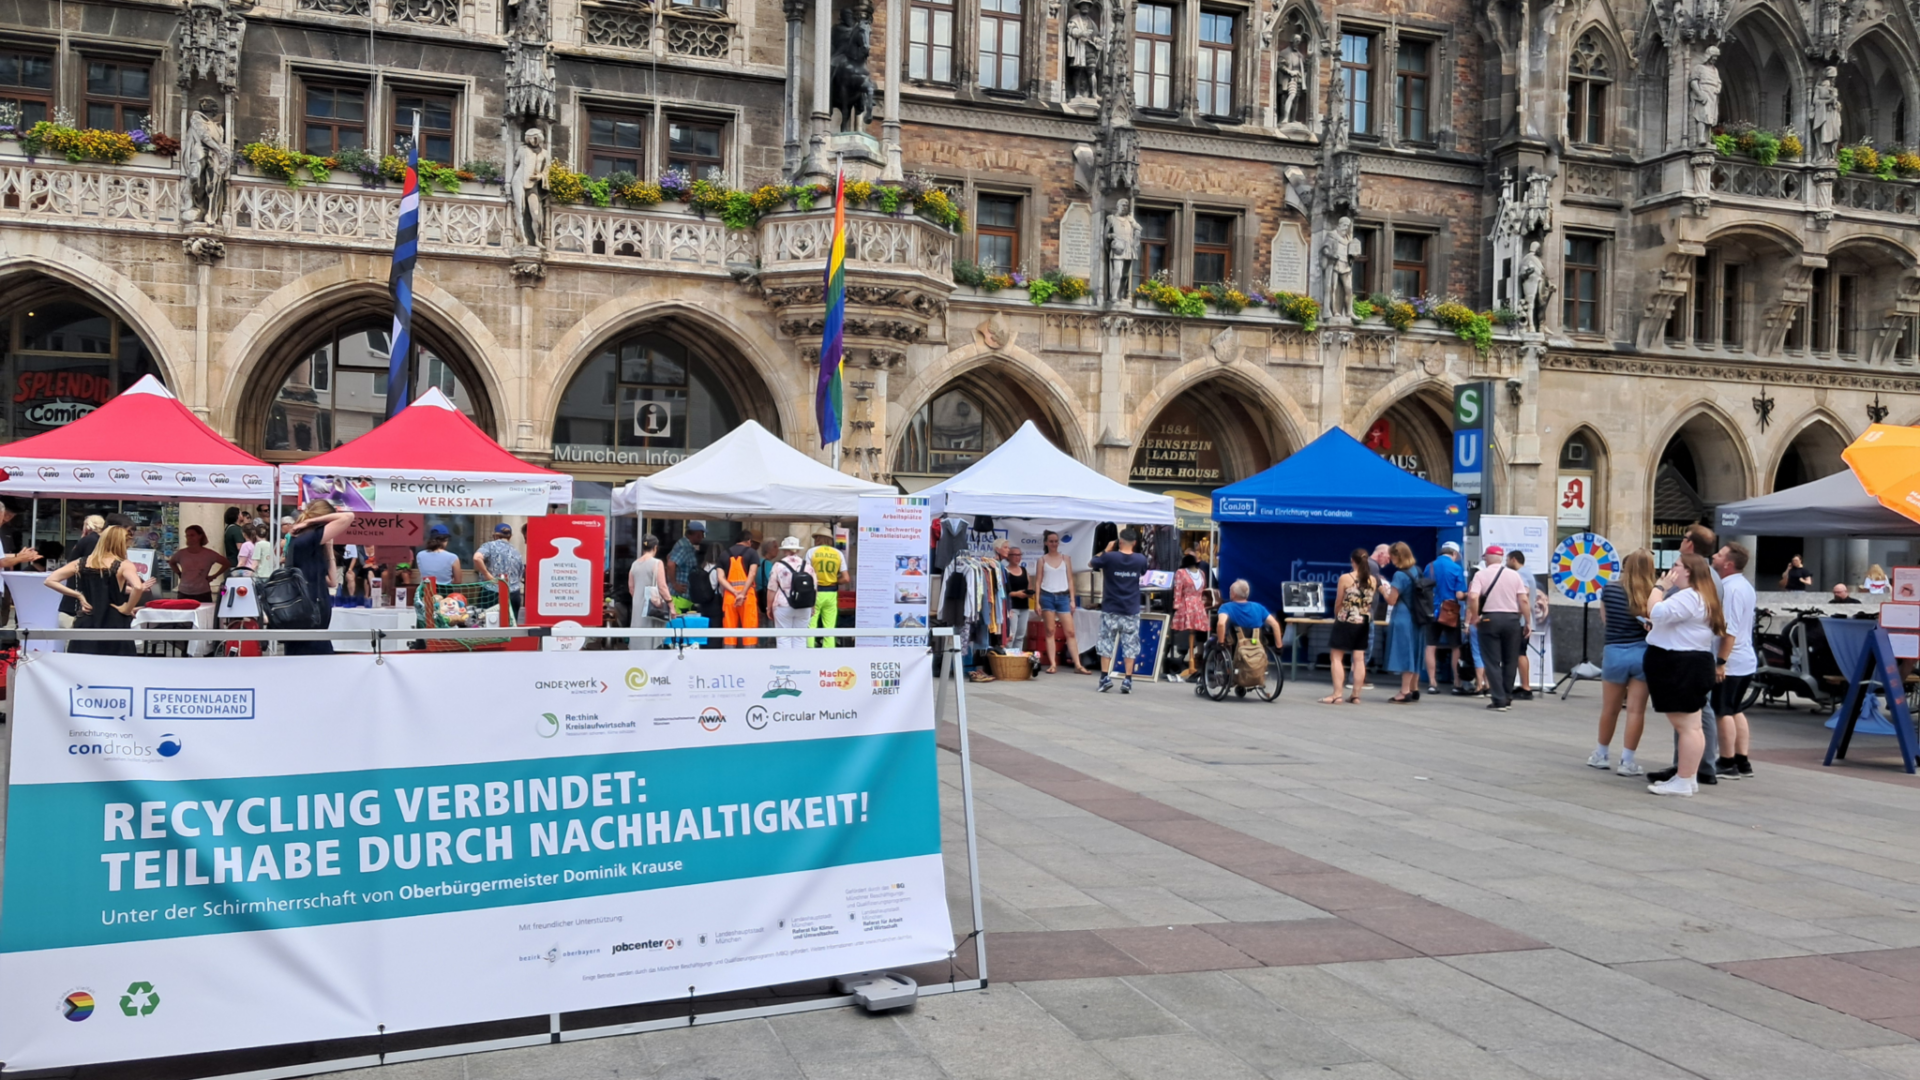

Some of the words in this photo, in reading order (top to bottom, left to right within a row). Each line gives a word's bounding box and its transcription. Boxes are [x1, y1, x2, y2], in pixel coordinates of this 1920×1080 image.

[1459, 390, 1478, 423] S
[1160, 425, 1190, 435] 1884
[1138, 439, 1213, 450] BERNSTEIN
[554, 445, 639, 464] München
[646, 450, 695, 466] Infor
[1152, 450, 1197, 460] LADEN
[1459, 434, 1476, 467] U
[1380, 453, 1417, 469] AUS
[1130, 467, 1172, 476] AMBER
[1178, 468, 1219, 478] HOUSE
[390, 482, 471, 495] RECYCLING-
[1453, 481, 1481, 489] Marienplatz
[417, 496, 493, 508] WERKSTATT
[1223, 502, 1251, 511] ConJob
[1260, 507, 1273, 515] Eine
[1275, 508, 1309, 517] Einrichtung
[882, 513, 922, 521] Arbeitsplätze
[885, 526, 922, 534] hochwertige
[818, 560, 836, 573] 10
[1297, 569, 1344, 583] ConJo
[893, 636, 928, 644] REGEN
[870, 662, 900, 670] REGEN
[819, 670, 848, 678] Machs
[870, 670, 900, 679] BOGEN
[696, 674, 745, 689] h.alle
[819, 680, 842, 688] Ganz
[872, 687, 900, 695] ARBEIT
[76, 698, 126, 709] CONJOB
[153, 693, 247, 704] SPENDENLADEN
[153, 704, 161, 714] &
[166, 704, 247, 714] SECONDHAND
[565, 713, 598, 721] Re:think
[772, 710, 816, 722] Circular
[819, 709, 857, 720] Munich
[565, 721, 636, 730] Kreislaufwirtschaft
[69, 729, 117, 739] Einrichtungen
[120, 731, 133, 739] von
[68, 740, 152, 757] condrobs
[104, 789, 381, 842] RECYCLING
[394, 770, 648, 823] VERBINDET:
[100, 839, 341, 892] TEILHABE
[358, 825, 513, 873] DURCH
[529, 791, 869, 858] NACHHALTIGKEIT!
[101, 908, 158, 925] Unter
[164, 903, 197, 920] der
[202, 890, 357, 917] Schirmherrschaft
[361, 889, 394, 903] von
[399, 869, 559, 901] Oberbürgermeister
[563, 862, 628, 884] Dominik
[631, 857, 683, 876] Krause
[519, 923, 531, 931] Mit
[533, 919, 573, 930] freundlicher
[575, 915, 624, 926] Unterstützung:
[715, 927, 765, 937] Landeshauptstadt
[803, 930, 839, 938] Umweltschutz
[715, 936, 742, 944] München
[612, 939, 664, 955] jobcenter
[519, 954, 541, 962] bezirk
[562, 948, 601, 958] oberbayern
